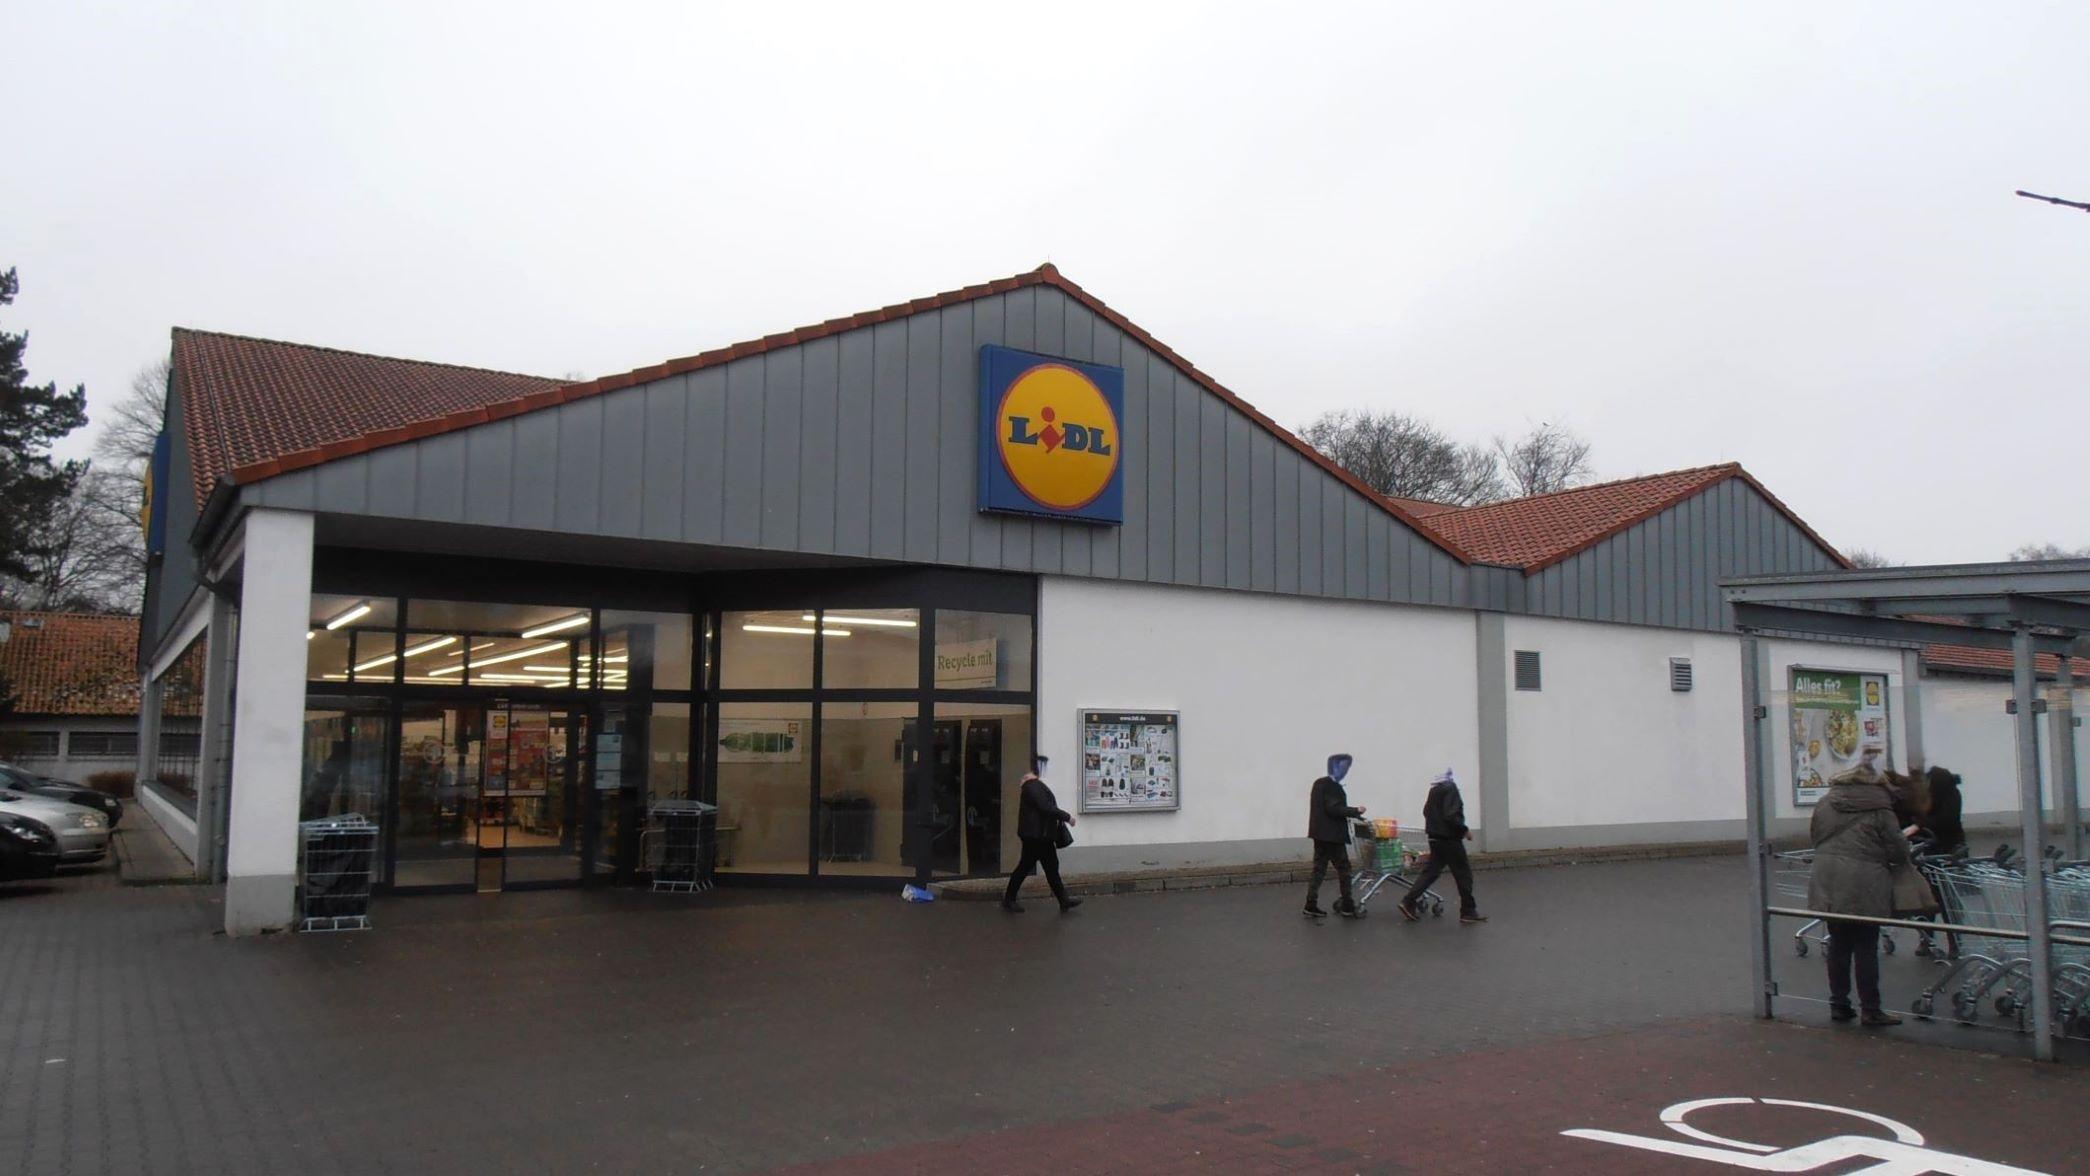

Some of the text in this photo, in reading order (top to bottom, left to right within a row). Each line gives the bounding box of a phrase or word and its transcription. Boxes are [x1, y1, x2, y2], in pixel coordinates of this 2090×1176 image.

[938, 650, 993, 672] Recycle mit
[1795, 677, 1842, 695] Alles fit?
